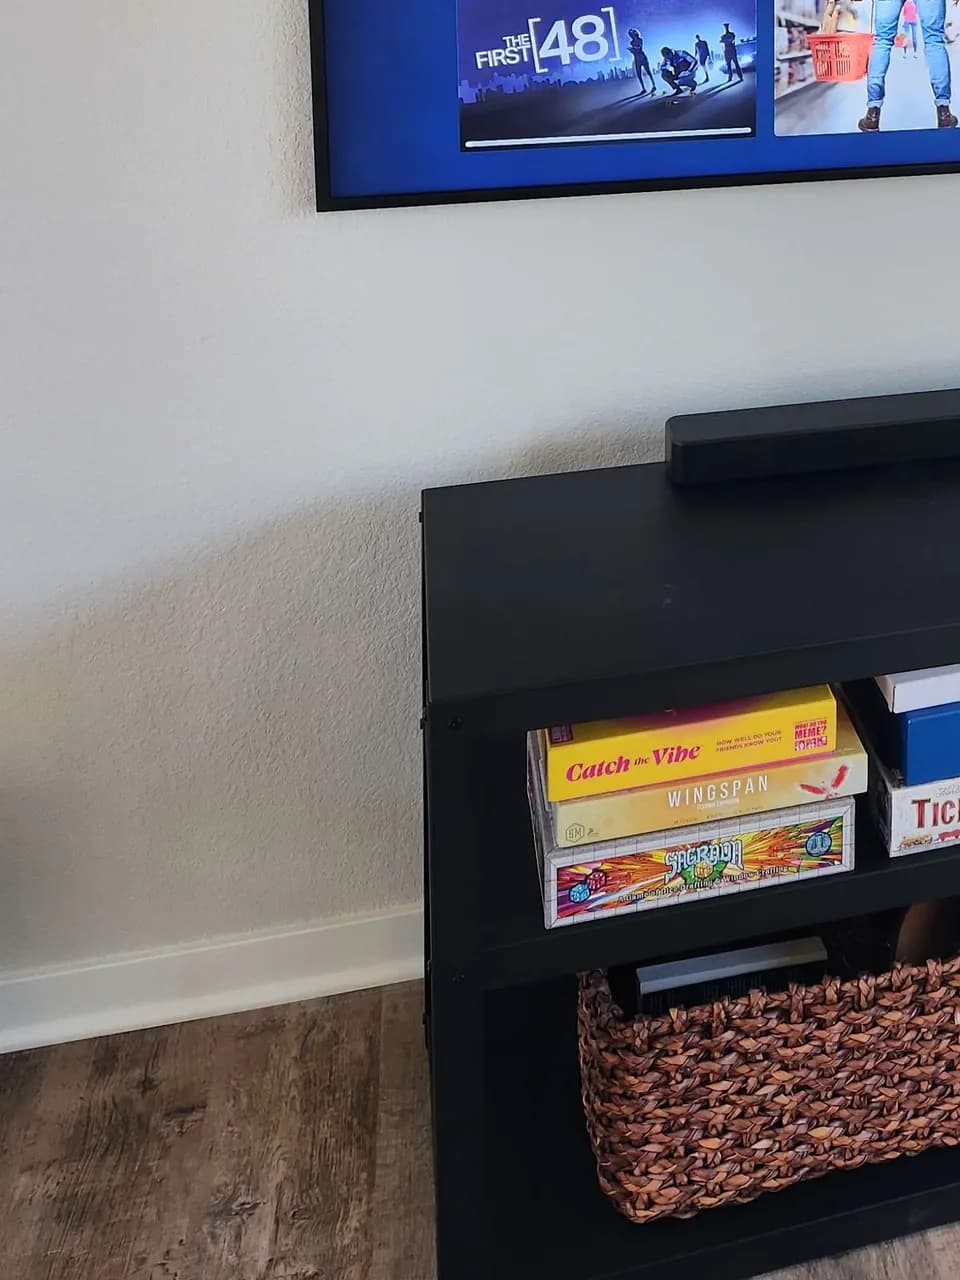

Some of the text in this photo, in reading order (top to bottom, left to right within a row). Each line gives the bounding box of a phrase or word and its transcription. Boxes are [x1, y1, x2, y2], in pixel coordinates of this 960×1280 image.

[503, 33, 530, 48] THE
[475, 44, 531, 69] FIRST
[795, 725, 827, 739] MEME?
[565, 744, 701, 783] Catch the Vibe
[668, 775, 768, 809] WINGSPAN
[664, 839, 745, 885] SAGRADA
